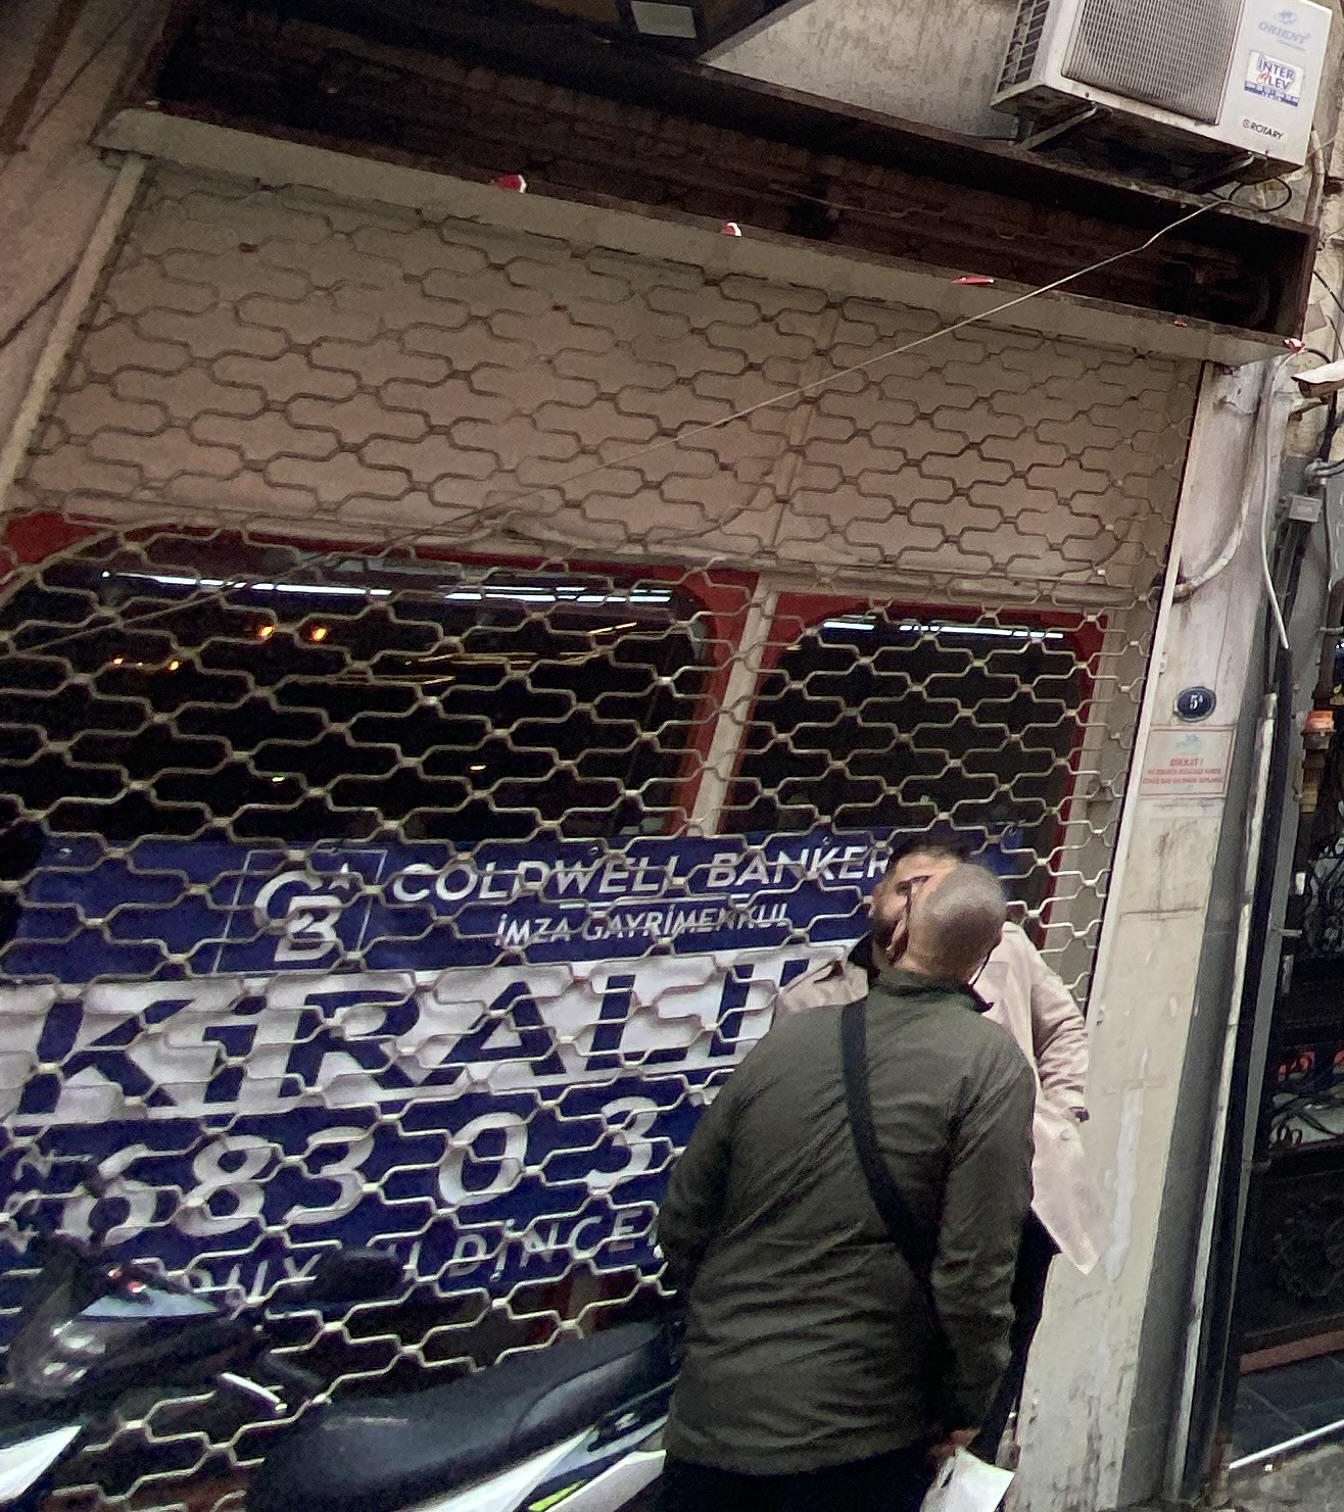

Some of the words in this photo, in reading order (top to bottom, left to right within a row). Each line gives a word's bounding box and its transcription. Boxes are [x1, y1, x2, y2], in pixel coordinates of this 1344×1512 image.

[1250, 120, 1285, 140] ROTARY
[393, 854, 687, 902] COLDWELL
[706, 844, 893, 889] BANKER
[494, 913, 572, 946] İMZA
